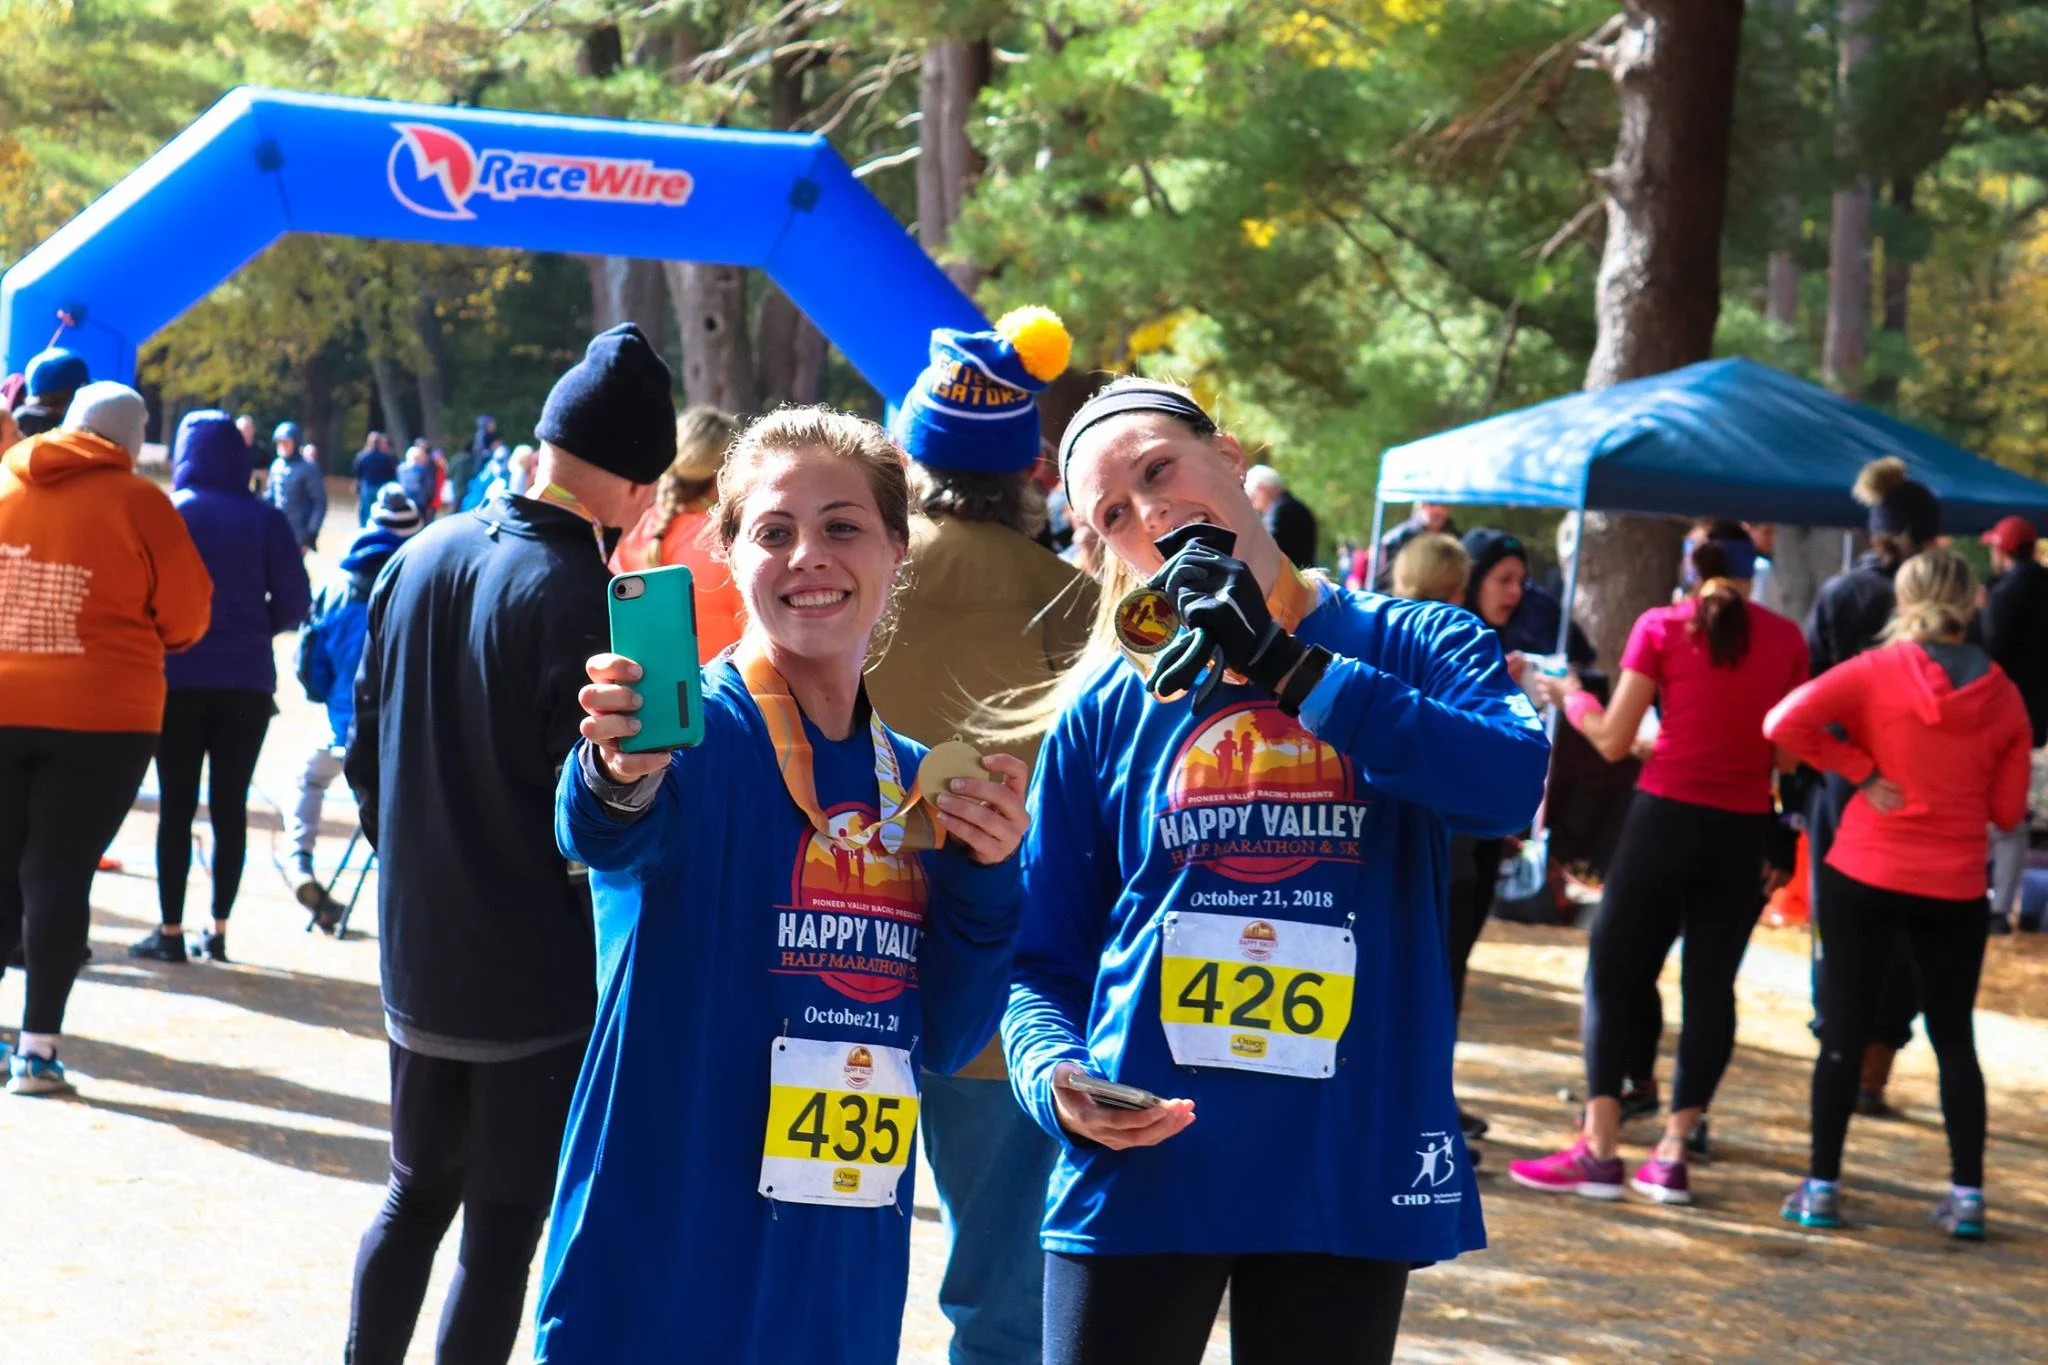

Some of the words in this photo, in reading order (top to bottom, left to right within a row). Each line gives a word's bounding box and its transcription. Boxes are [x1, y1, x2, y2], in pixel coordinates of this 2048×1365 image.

[478, 151, 693, 204] RaceWire
[1187, 794, 1225, 803] PIONEER
[1227, 790, 1256, 800] VALLEY
[1257, 789, 1288, 799] RACING
[1290, 790, 1334, 799] PRESENTS
[1159, 803, 1253, 850] HAPPY
[1261, 803, 1367, 838] VALLEY
[1213, 839, 1315, 855] MARATHON
[1320, 840, 1333, 854] &
[1340, 841, 1360, 856] 5K
[812, 898, 846, 909] PIONEER
[1190, 889, 1258, 907] October
[1262, 889, 1288, 908] 21,
[1292, 889, 1334, 907] 2018
[778, 912, 868, 952] HAPPY
[875, 919, 917, 963] VALL
[781, 951, 828, 967] HALF
[828, 954, 907, 977] MARATHON
[1177, 961, 1326, 1035] 426
[804, 1006, 865, 1027] October
[864, 1011, 885, 1033] 21,
[886, 1014, 900, 1033] 20
[787, 1091, 900, 1164] 435
[1391, 1193, 1431, 1206] CHD
